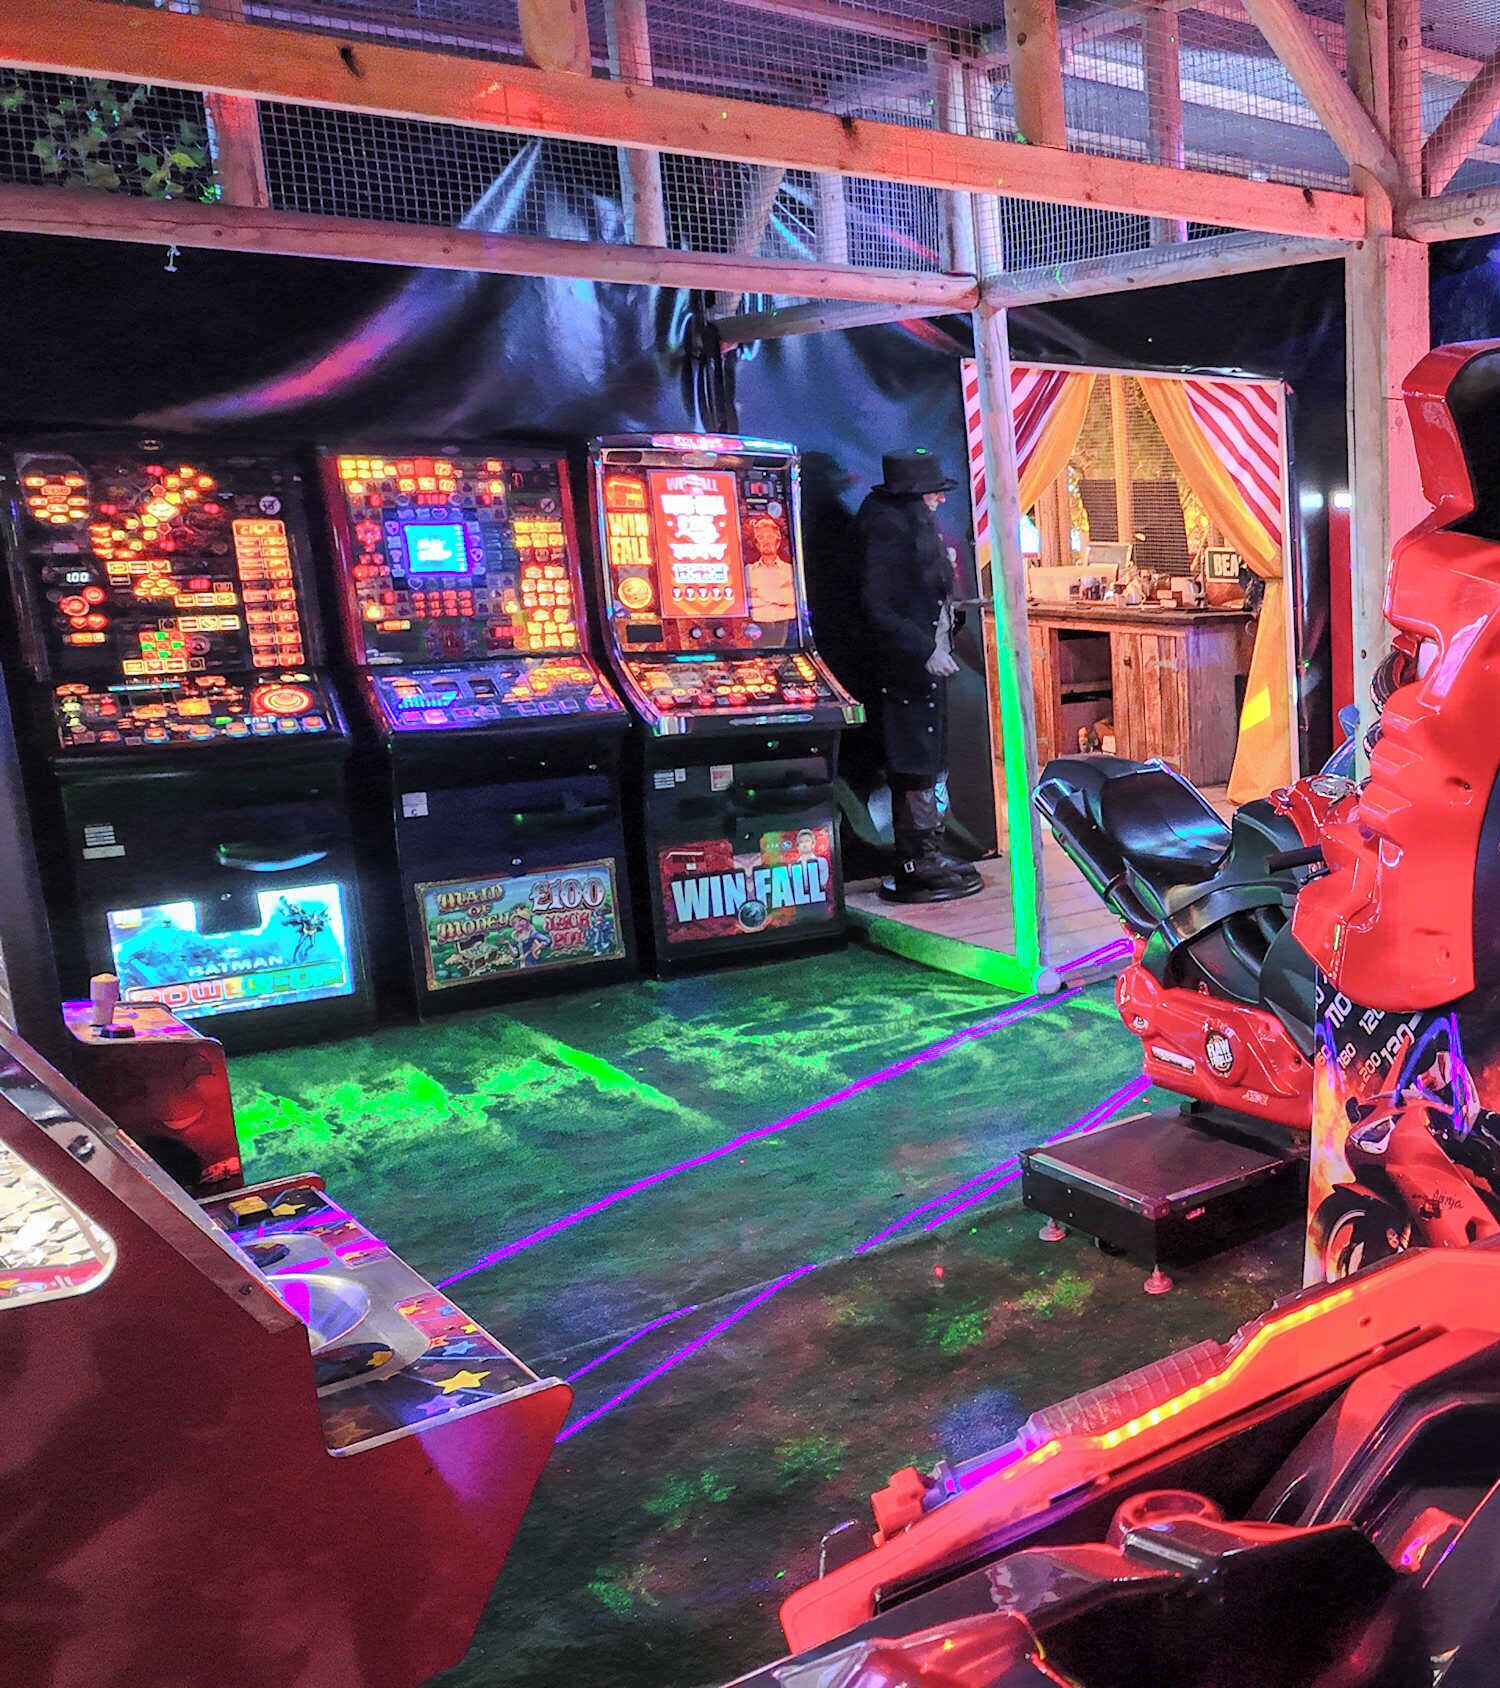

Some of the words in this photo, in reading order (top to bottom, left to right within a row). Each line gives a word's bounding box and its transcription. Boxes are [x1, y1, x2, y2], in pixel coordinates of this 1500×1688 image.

[608, 513, 649, 536] WIN
[610, 537, 652, 565] FALL
[530, 877, 607, 913] £100
[670, 872, 747, 923] WIN
[754, 862, 827, 909] FALL
[436, 912, 512, 944] MONEY
[188, 954, 284, 977] BATMAN
[1325, 991, 1353, 1029] 110
[1206, 1038, 1231, 1062] RAW
